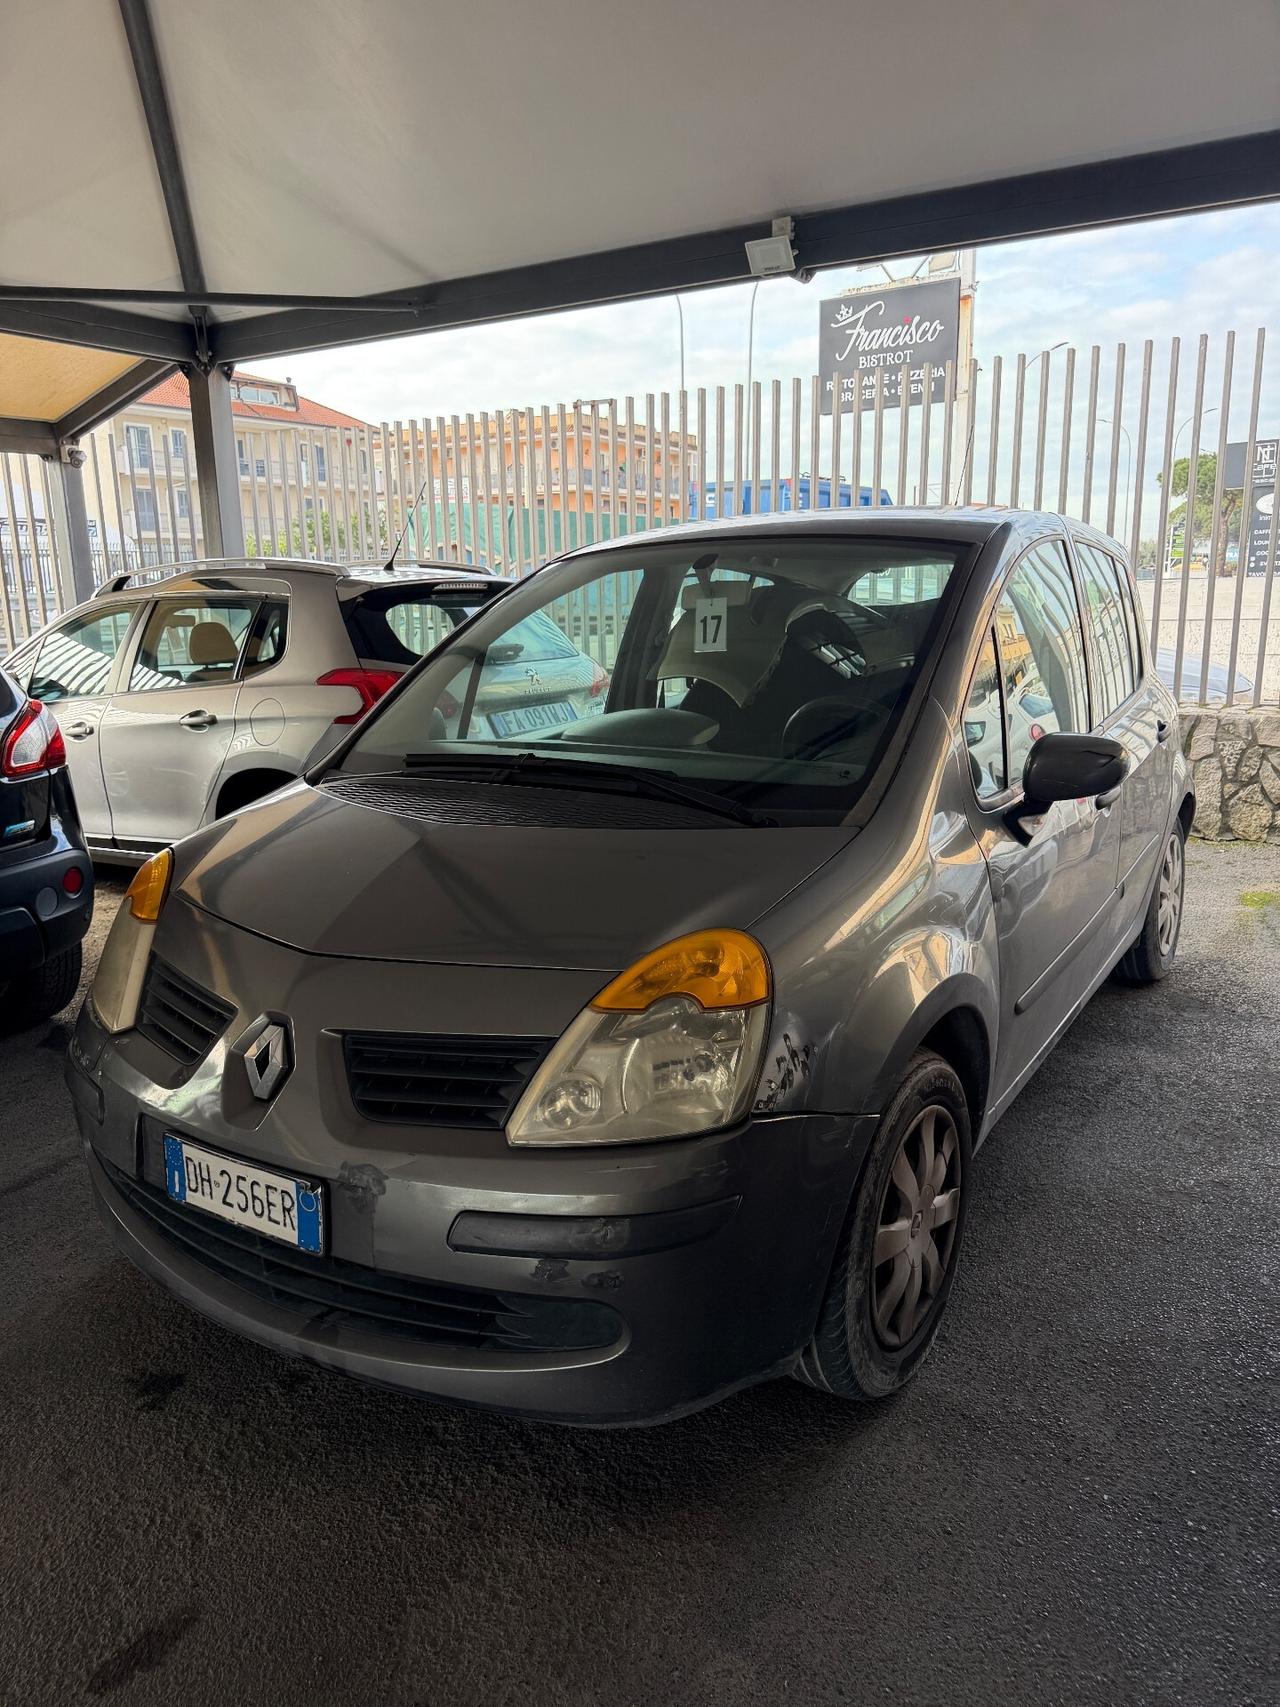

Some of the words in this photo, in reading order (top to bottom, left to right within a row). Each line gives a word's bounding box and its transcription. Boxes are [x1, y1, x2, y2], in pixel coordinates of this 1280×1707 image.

[831, 301, 944, 361] Francisco
[859, 350, 914, 369] BISTROT
[700, 615, 723, 644] 17
